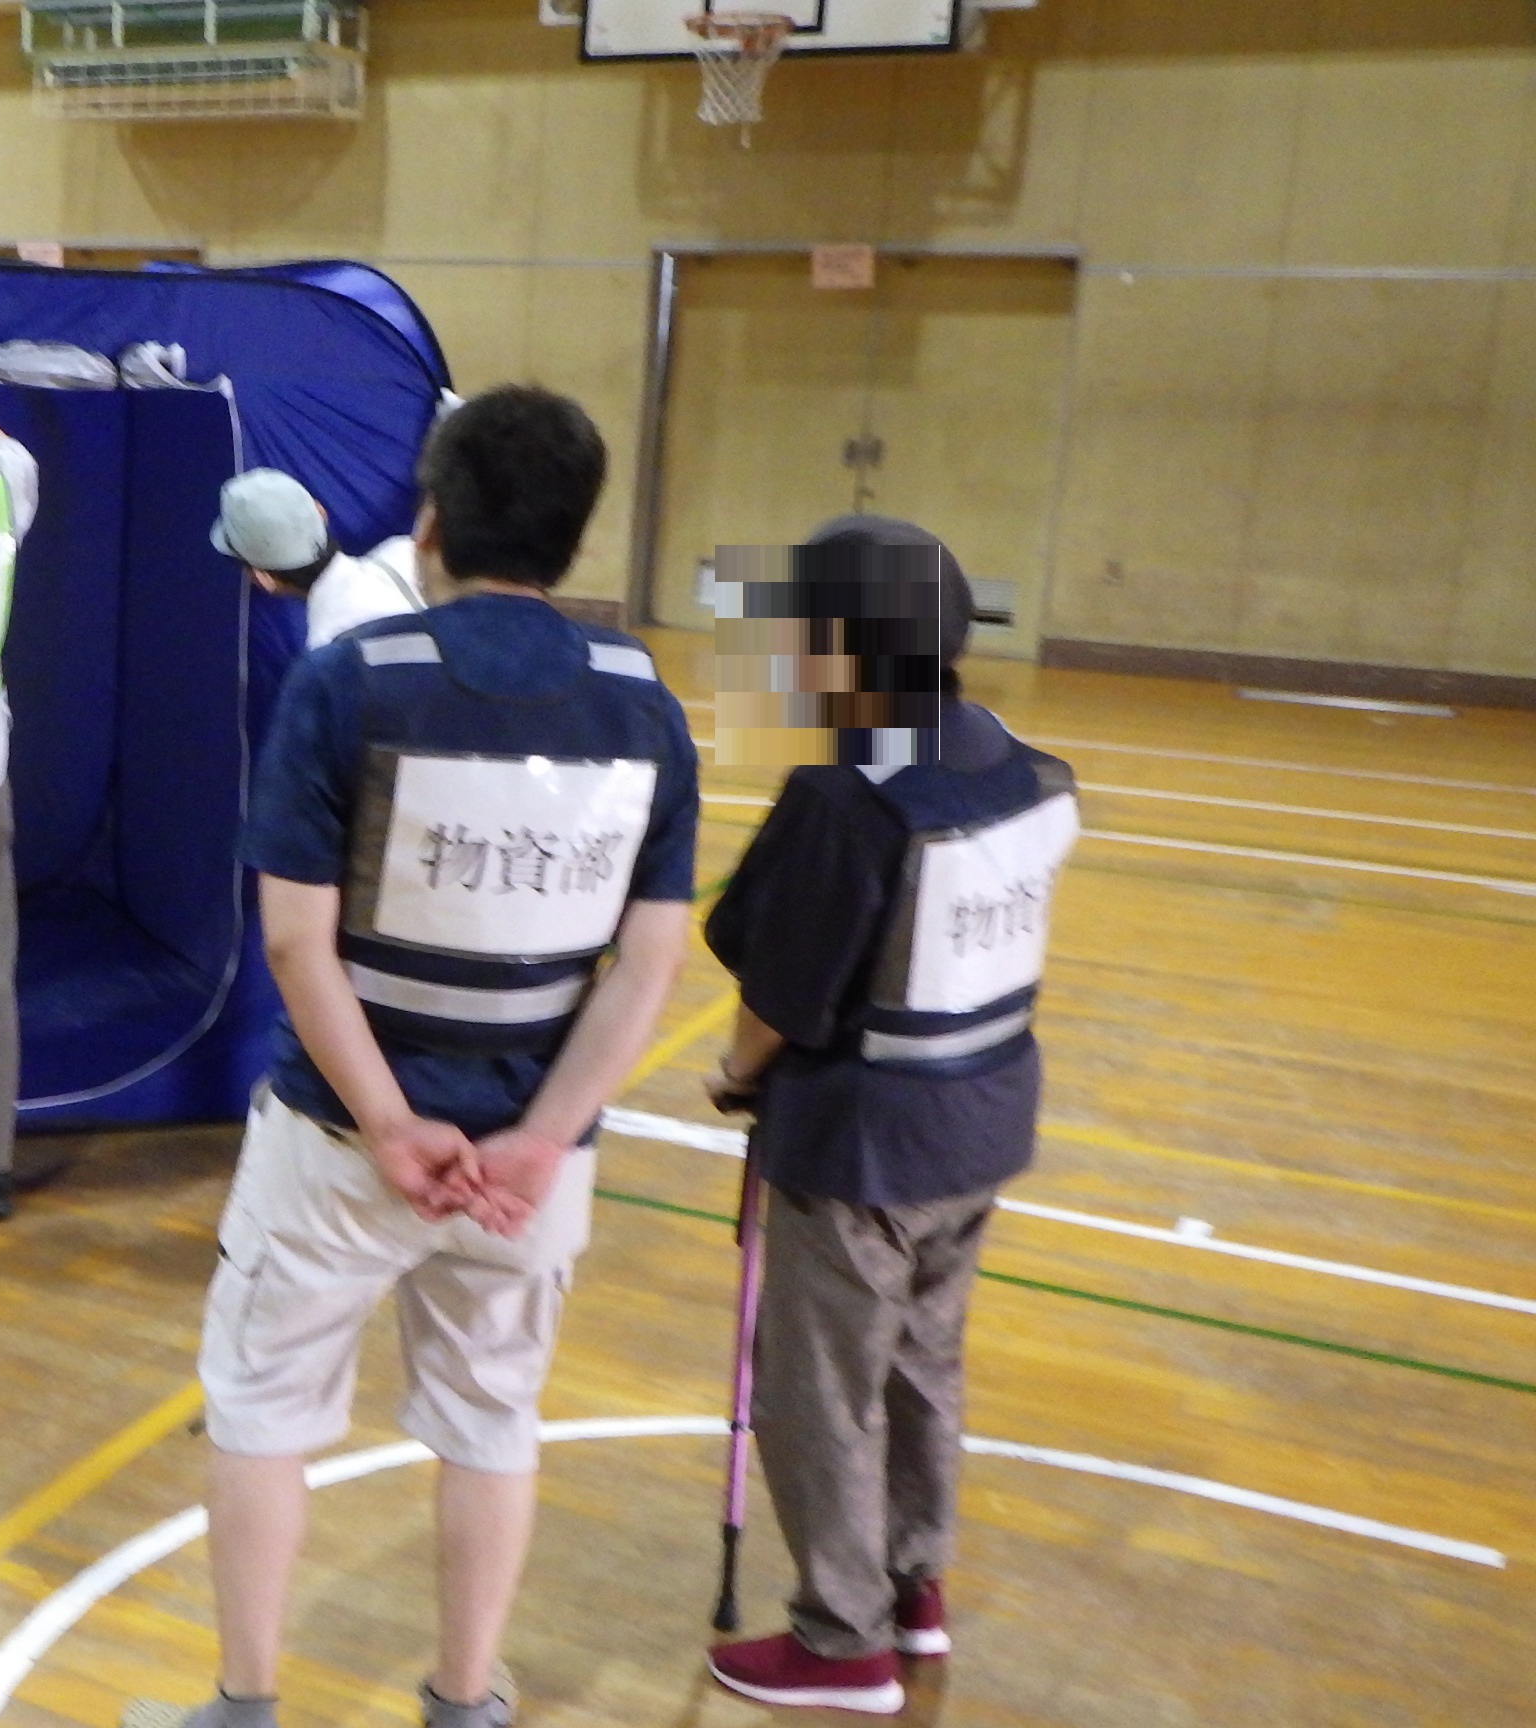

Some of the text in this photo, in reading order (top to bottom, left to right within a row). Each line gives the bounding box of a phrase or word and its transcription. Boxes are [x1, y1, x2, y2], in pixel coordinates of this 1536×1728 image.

[419, 823, 623, 896] 物資部
[946, 868, 1052, 958] 物資
